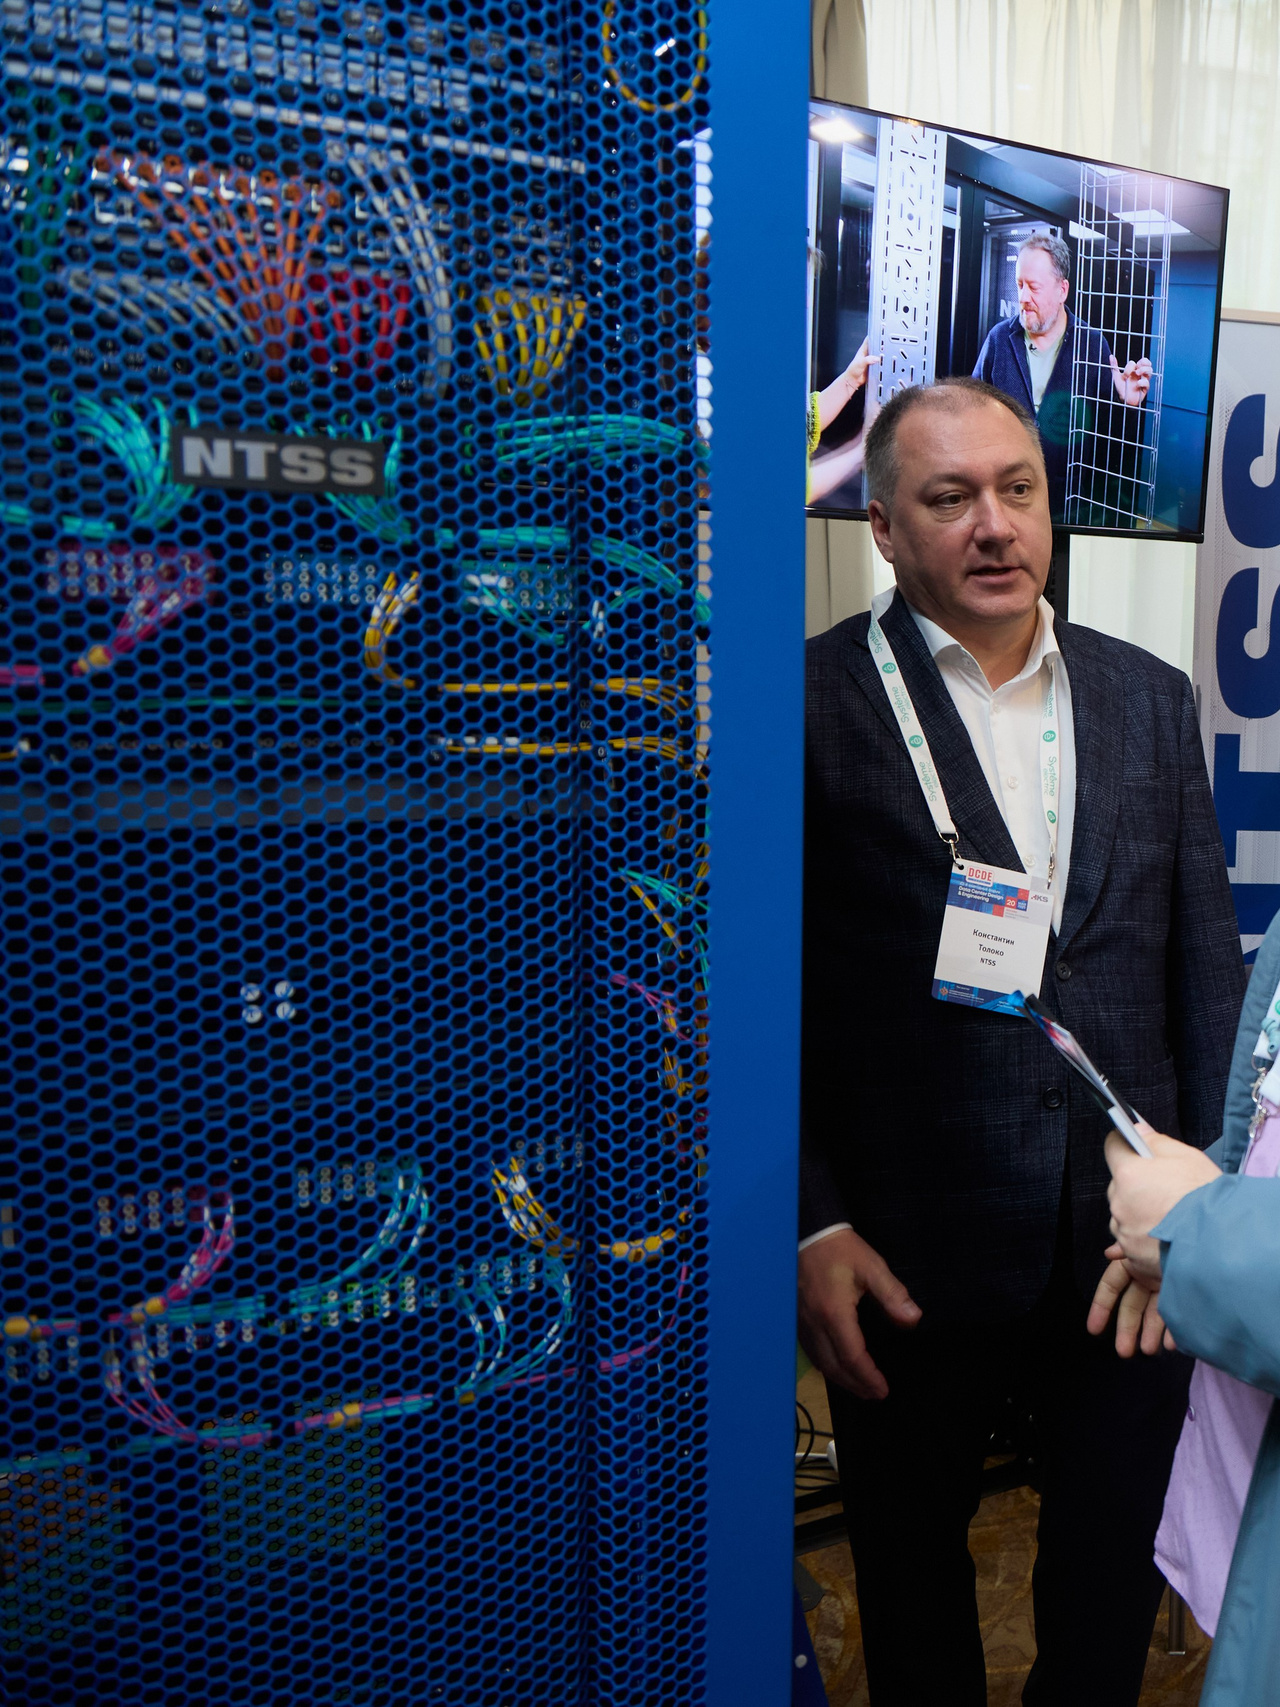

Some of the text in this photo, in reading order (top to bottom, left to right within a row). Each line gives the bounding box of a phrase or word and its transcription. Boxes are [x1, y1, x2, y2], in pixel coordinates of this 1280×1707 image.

[182, 436, 375, 487] NTSS
[968, 867, 993, 881] DCDE
[1006, 899, 1016, 907] 20
[972, 928, 1015, 946] Константин
[978, 943, 1005, 957] Толоко
[980, 957, 997, 967] NTSS
